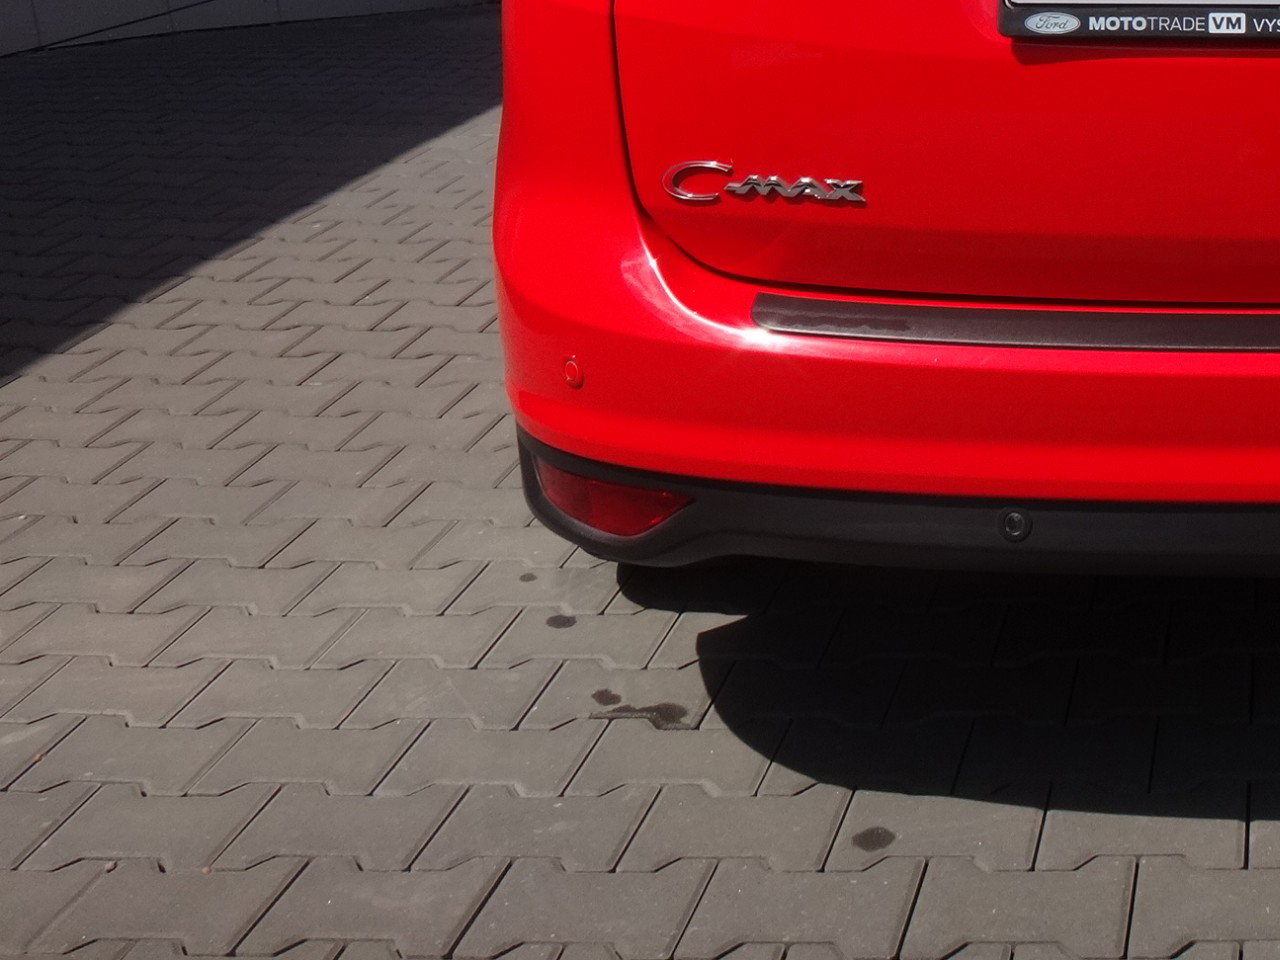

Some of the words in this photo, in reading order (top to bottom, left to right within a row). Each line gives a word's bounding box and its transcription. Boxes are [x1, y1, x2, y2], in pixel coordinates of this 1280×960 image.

[1035, 13, 1069, 30] Ford
[1088, 16, 1206, 32] MOTOTRADE
[1212, 16, 1243, 31] VM
